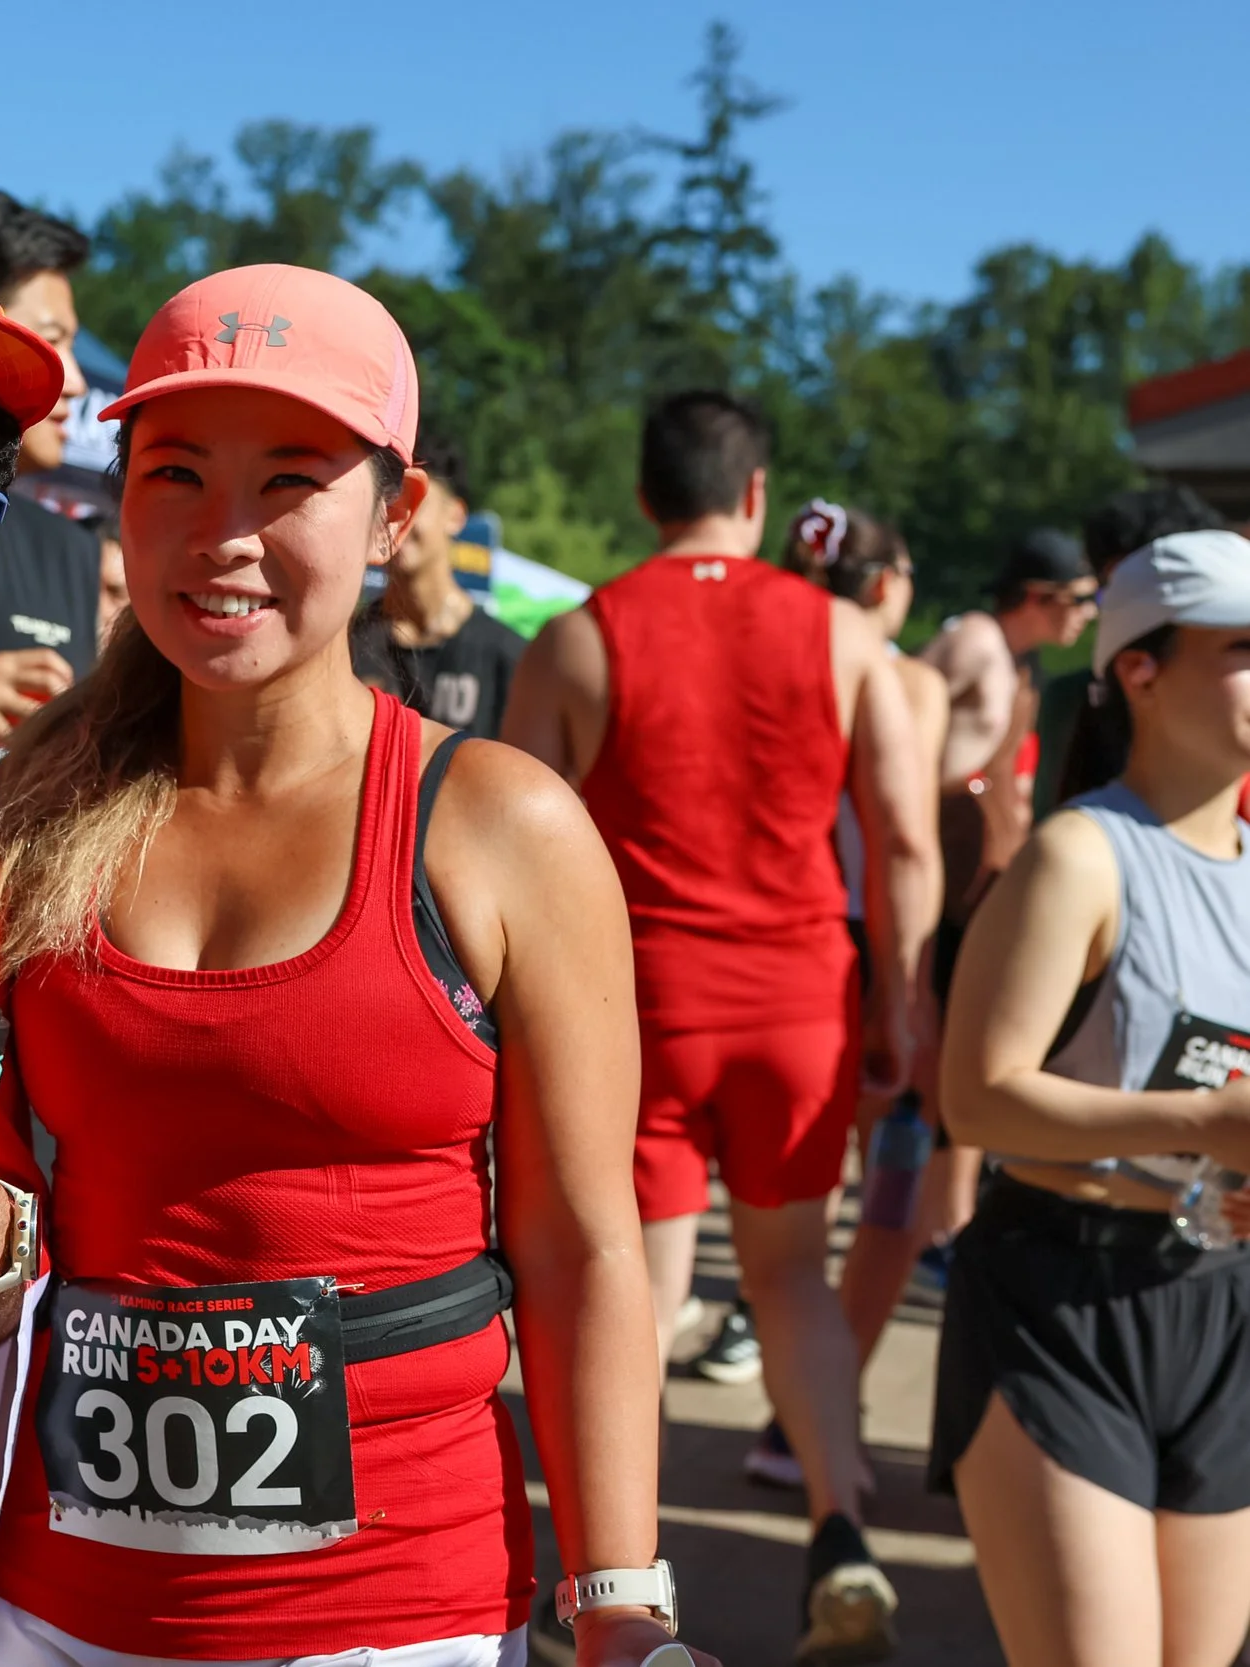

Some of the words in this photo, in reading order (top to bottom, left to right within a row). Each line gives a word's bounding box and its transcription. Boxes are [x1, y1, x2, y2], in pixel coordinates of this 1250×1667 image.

[119, 1294, 165, 1311] KAMINO
[167, 1301, 204, 1313] RACE
[207, 1297, 255, 1312] SERIES
[64, 1308, 214, 1352] CANADA
[224, 1314, 306, 1350] DAY
[61, 1342, 129, 1382] RUN
[136, 1342, 313, 1387] 5+10KM
[74, 1388, 303, 1507] 302
